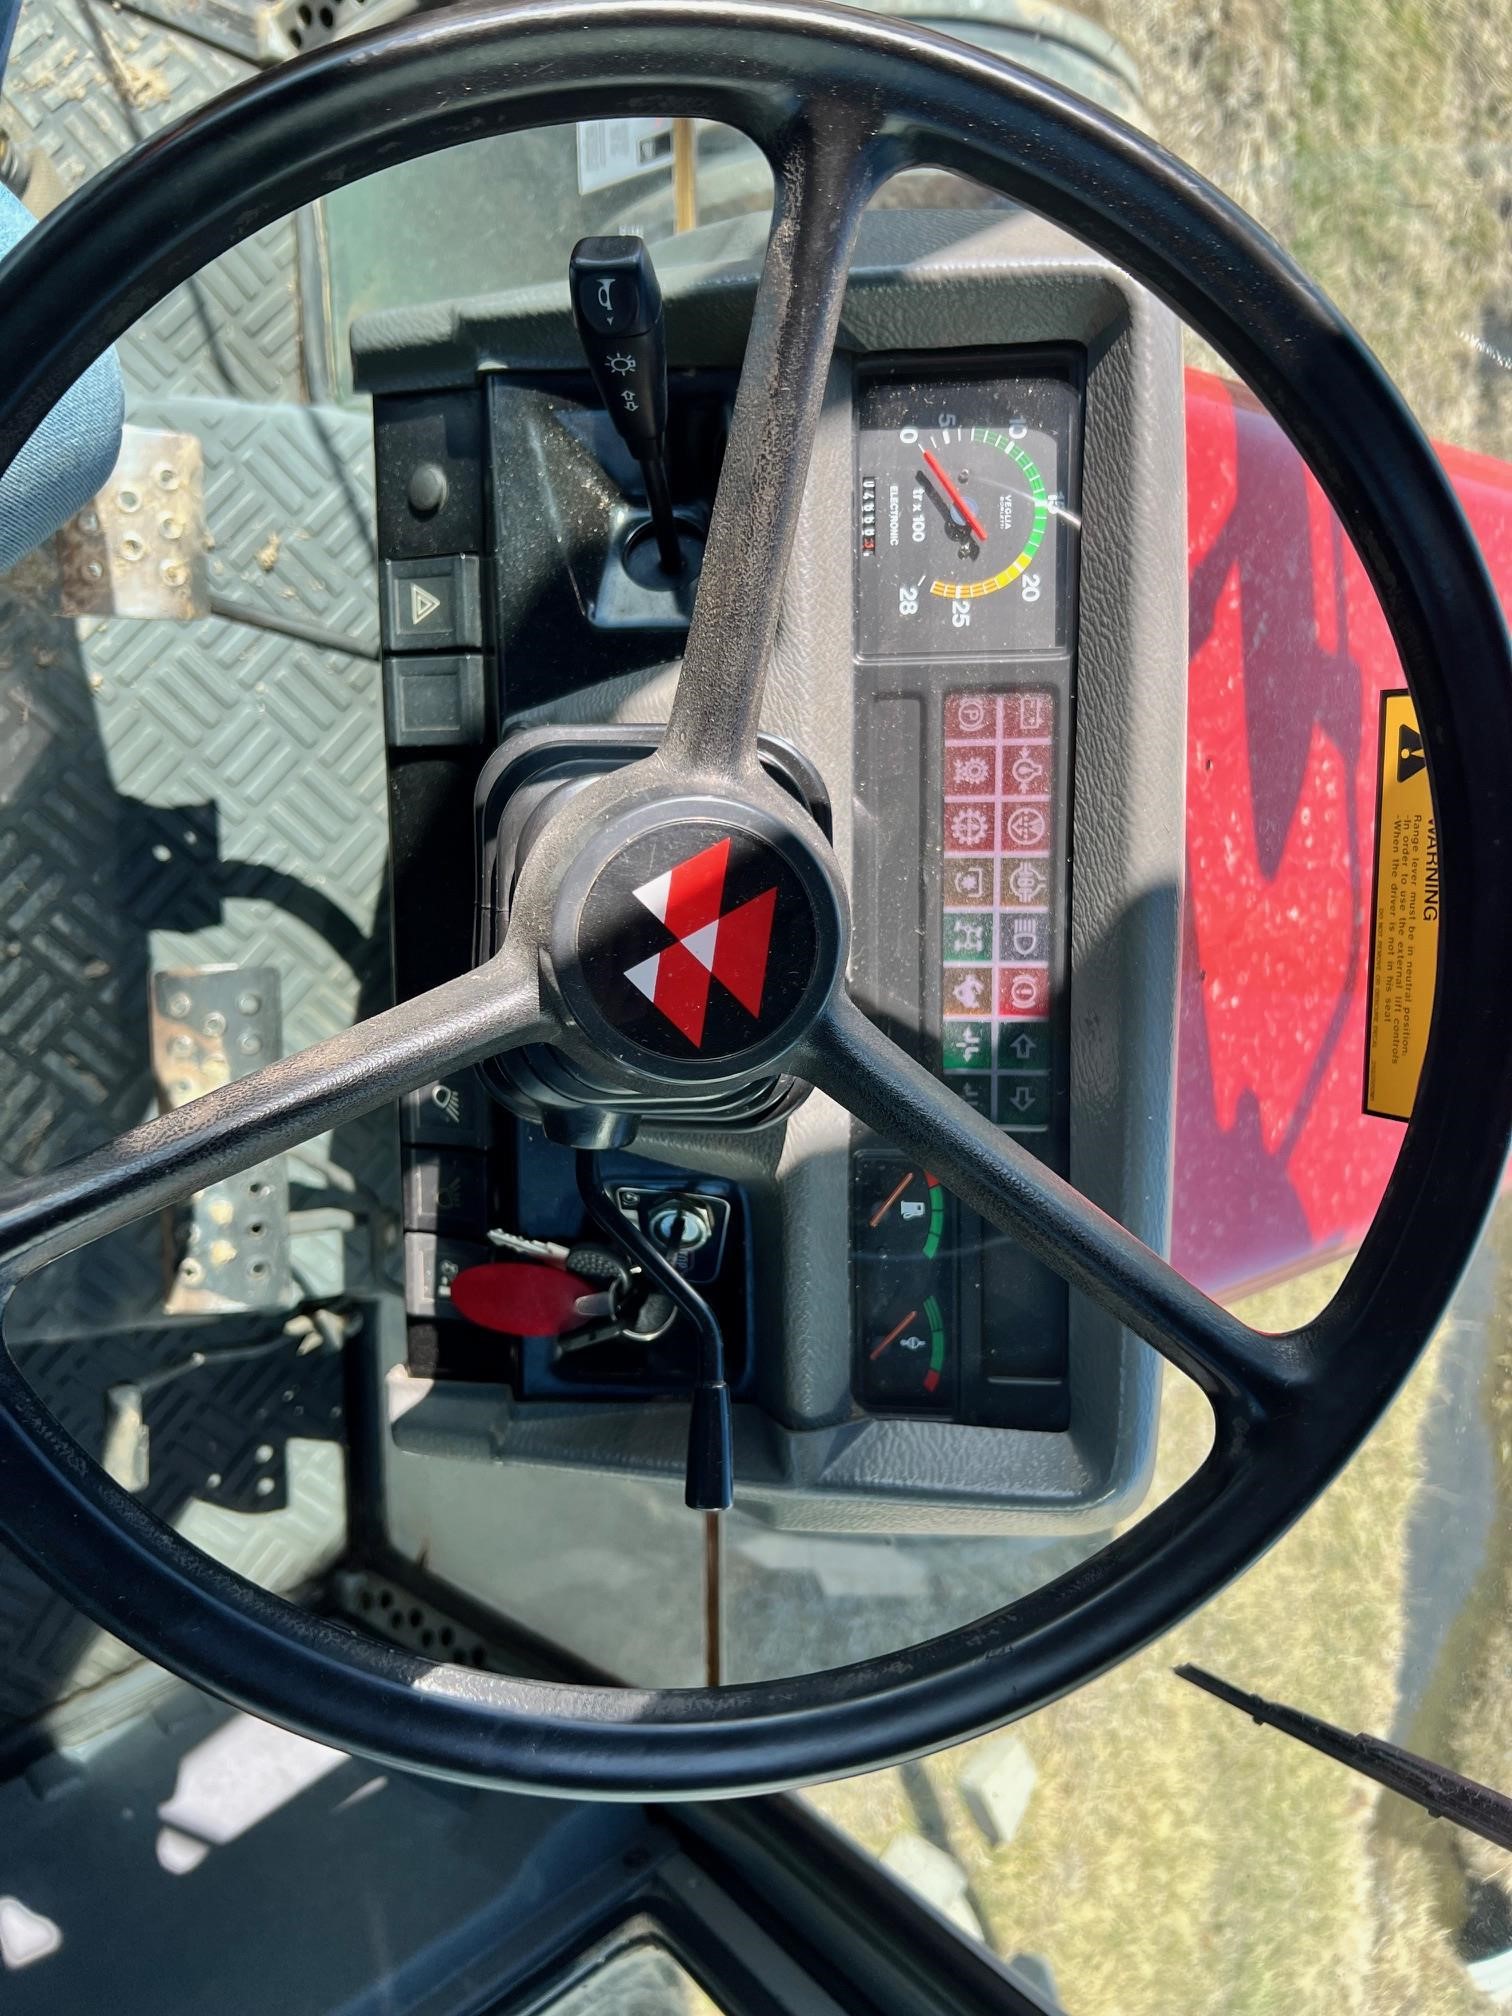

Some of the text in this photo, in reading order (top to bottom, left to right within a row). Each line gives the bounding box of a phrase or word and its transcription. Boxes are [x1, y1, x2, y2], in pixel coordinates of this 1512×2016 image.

[938, 414, 955, 428] 5
[1008, 417, 1027, 439] 10
[899, 426, 918, 444] 0
[912, 487, 925, 501] tr
[889, 485, 899, 546] ELECTRONIC
[1004, 495, 1012, 529] VEGLIA
[912, 514, 926, 543] 100
[1022, 574, 1041, 602] 20
[898, 587, 918, 616] 28
[952, 601, 971, 628] 25
[1411, 815, 1422, 852] Range
[1401, 836, 1410, 866] order
[1391, 859, 1400, 877] the
[1400, 874, 1408, 884] to
[1411, 858, 1420, 885] lever
[1389, 884, 1398, 916] driver
[1399, 891, 1407, 911] use
[1409, 892, 1417, 920] must
[1388, 922, 1397, 931] is
[1398, 917, 1407, 935] the
[1408, 926, 1416, 940] be
[1387, 937, 1396, 955] not
[1407, 946, 1415, 956] in
[1386, 961, 1394, 971] in
[1395, 941, 1405, 988] external
[1385, 976, 1394, 992] his
[1404, 961, 1413, 1003] neutral
[1383, 998, 1392, 1024] seat
[1394, 996, 1402, 1012] lift
[1391, 1018, 1401, 1064] controls
